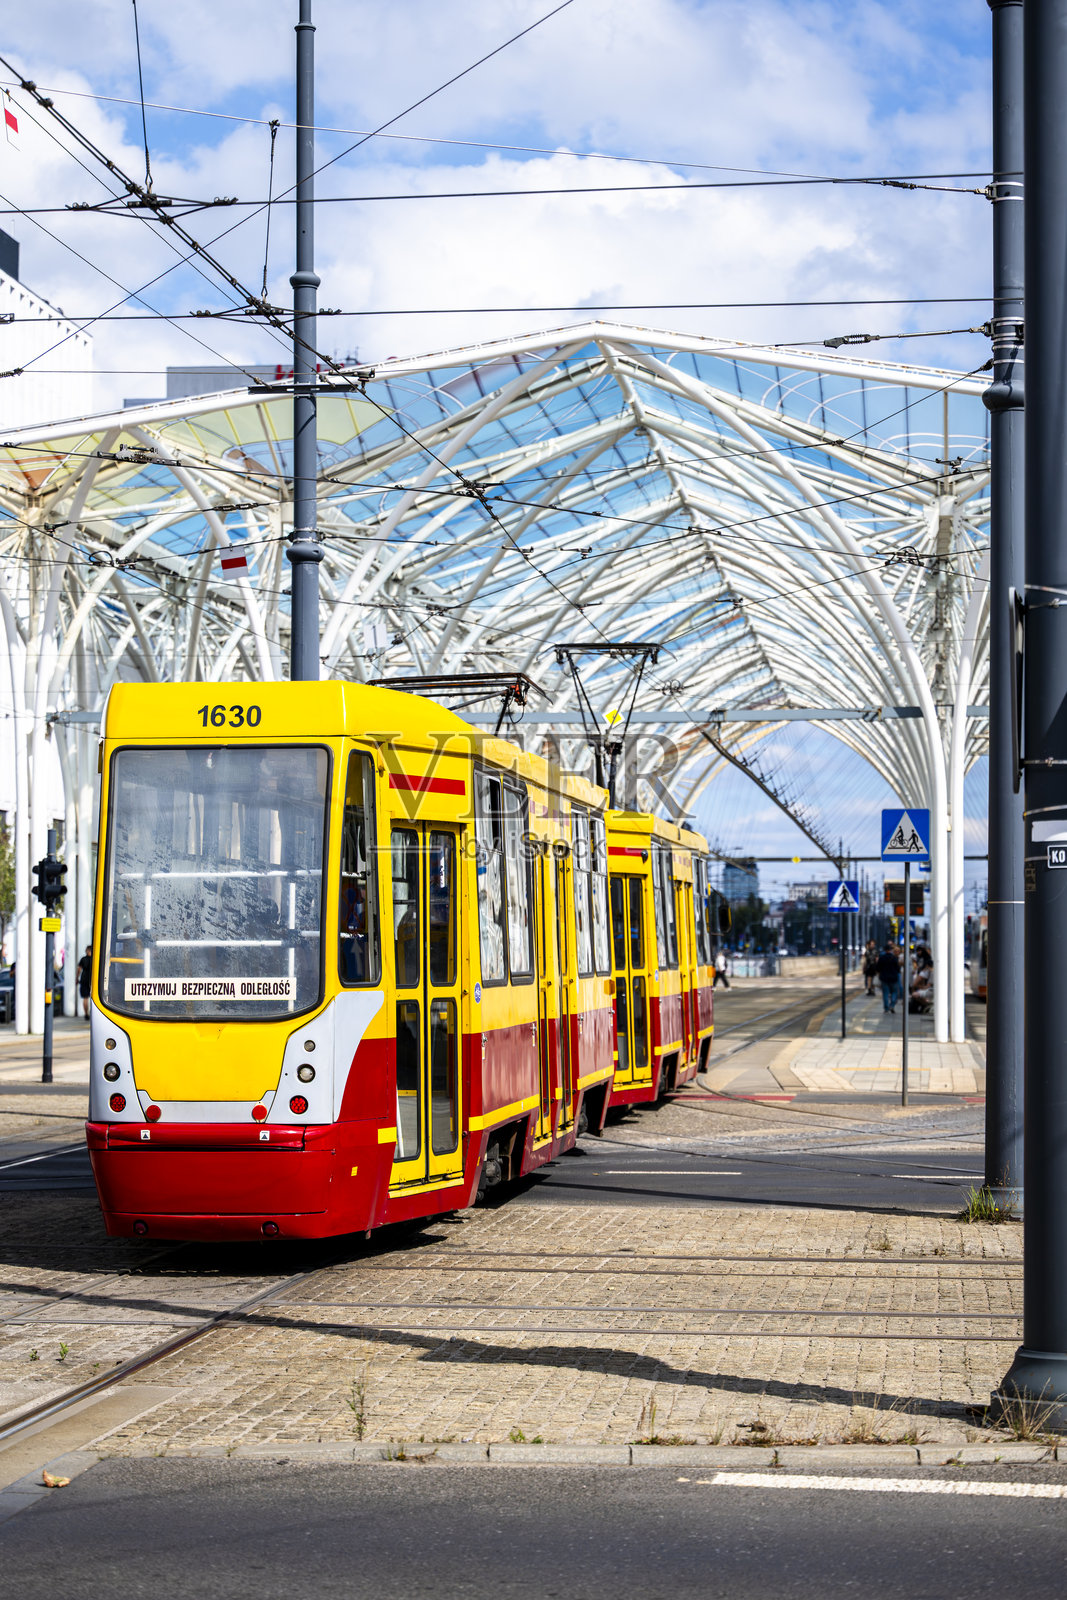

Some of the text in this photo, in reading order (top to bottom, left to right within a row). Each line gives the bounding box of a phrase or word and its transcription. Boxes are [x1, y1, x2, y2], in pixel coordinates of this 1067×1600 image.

[198, 704, 262, 728] 1630
[131, 980, 291, 998] UTRZYMUJ BEZPIECZNĄ ODLEGŁOŚĆ
